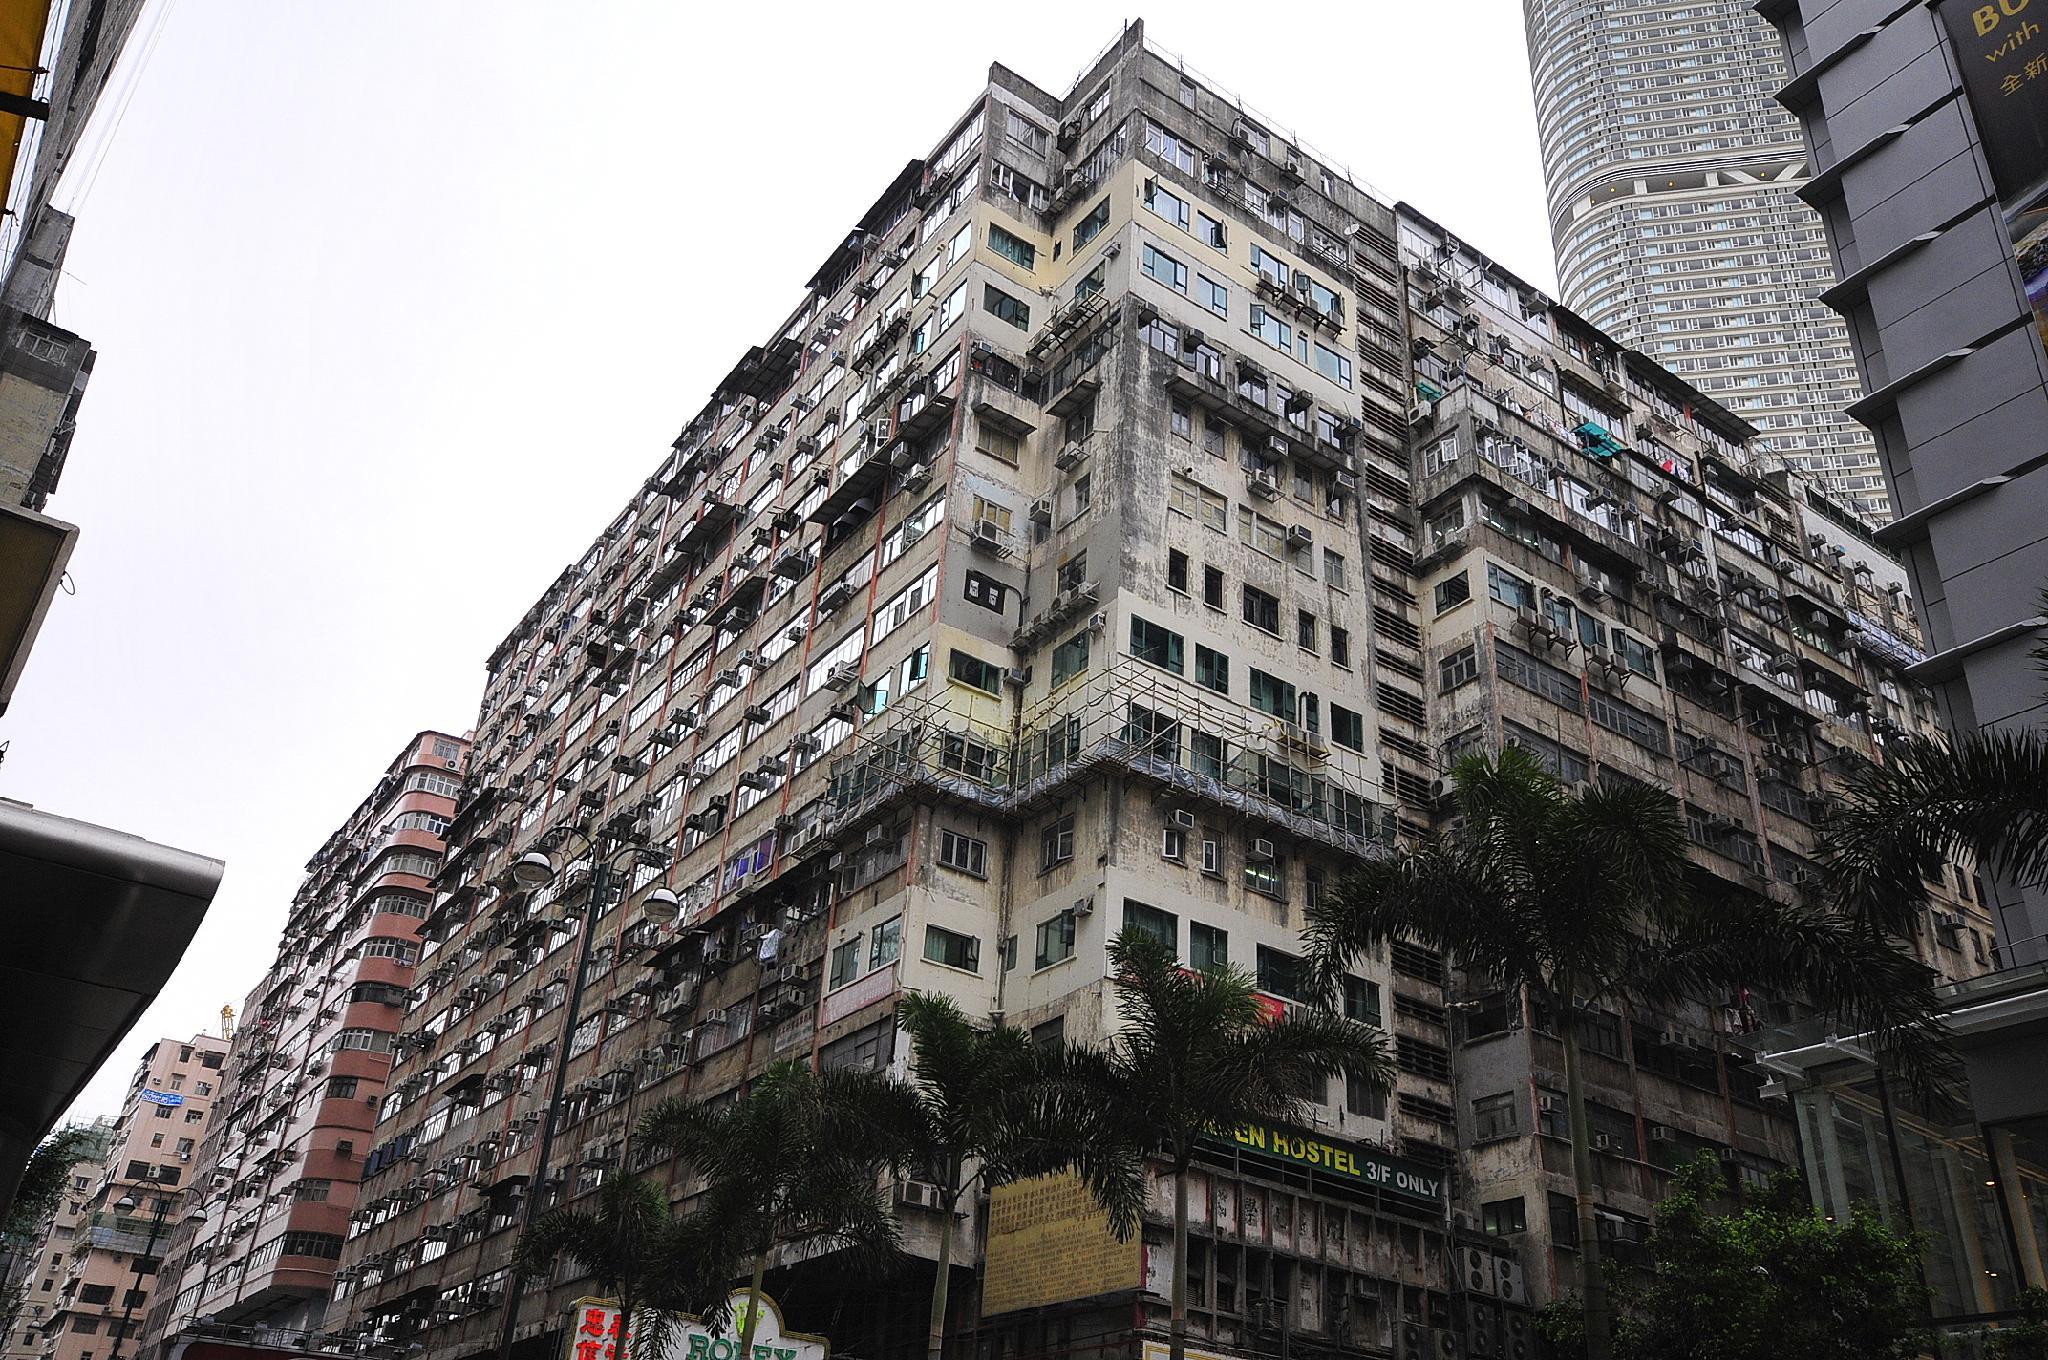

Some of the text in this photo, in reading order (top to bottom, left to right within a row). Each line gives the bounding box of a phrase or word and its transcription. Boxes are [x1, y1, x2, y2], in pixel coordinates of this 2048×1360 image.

[1984, 21, 2040, 62] with
[2000, 52, 2048, 97] 全新
[1273, 1131, 1361, 1177] HOSTEL
[1366, 1161, 1391, 1183] 3/F
[1396, 1171, 1439, 1198] ONLY
[688, 1333, 797, 1360] ROEX
